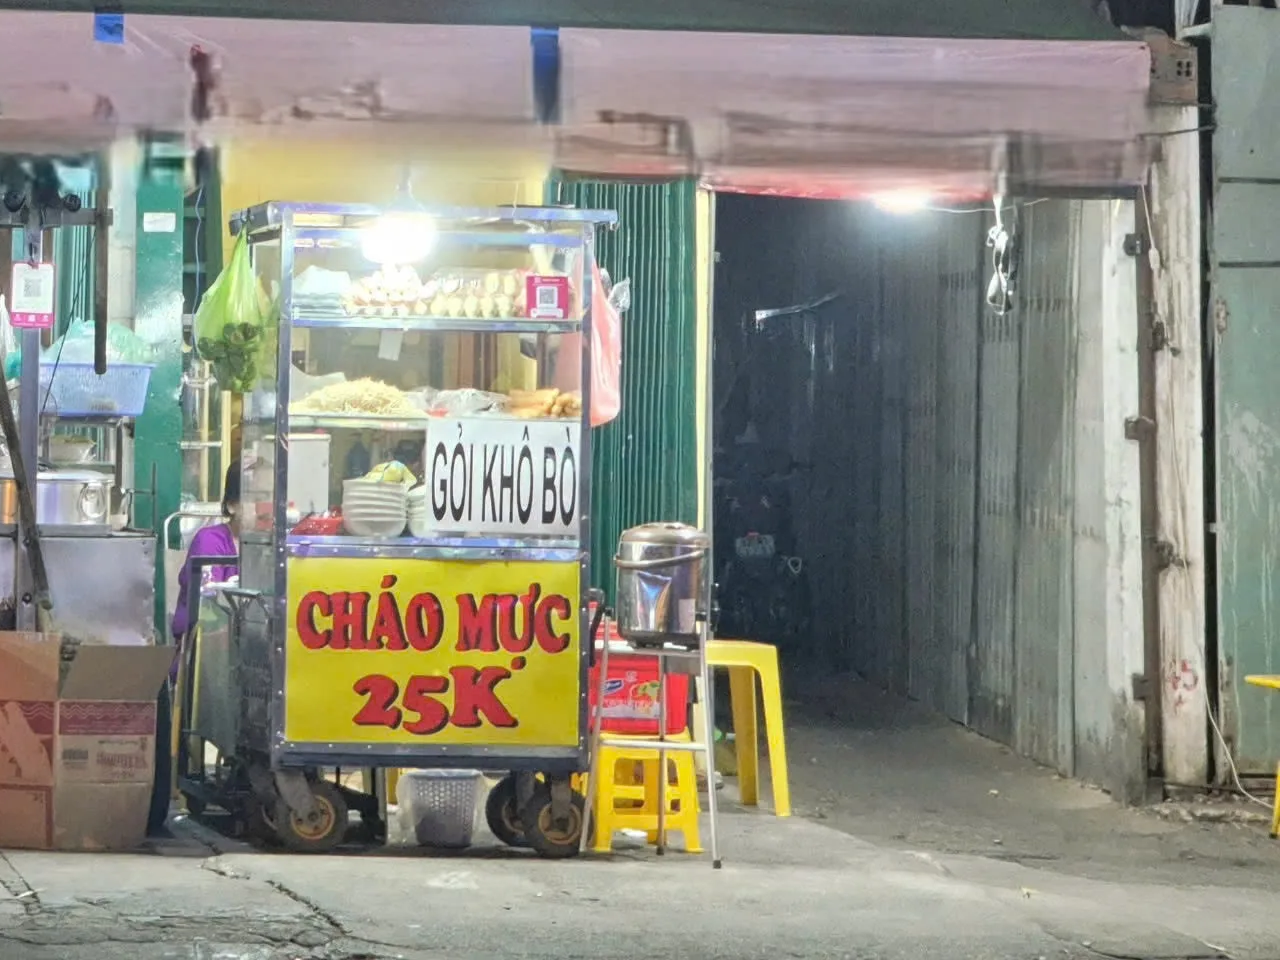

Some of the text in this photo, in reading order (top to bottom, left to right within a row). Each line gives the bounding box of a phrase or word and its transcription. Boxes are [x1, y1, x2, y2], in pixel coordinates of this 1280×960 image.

[431, 421, 577, 526] GỎI KHÔ BÒ
[295, 574, 572, 672] CHÁO MỰC
[351, 664, 519, 736] 25K
